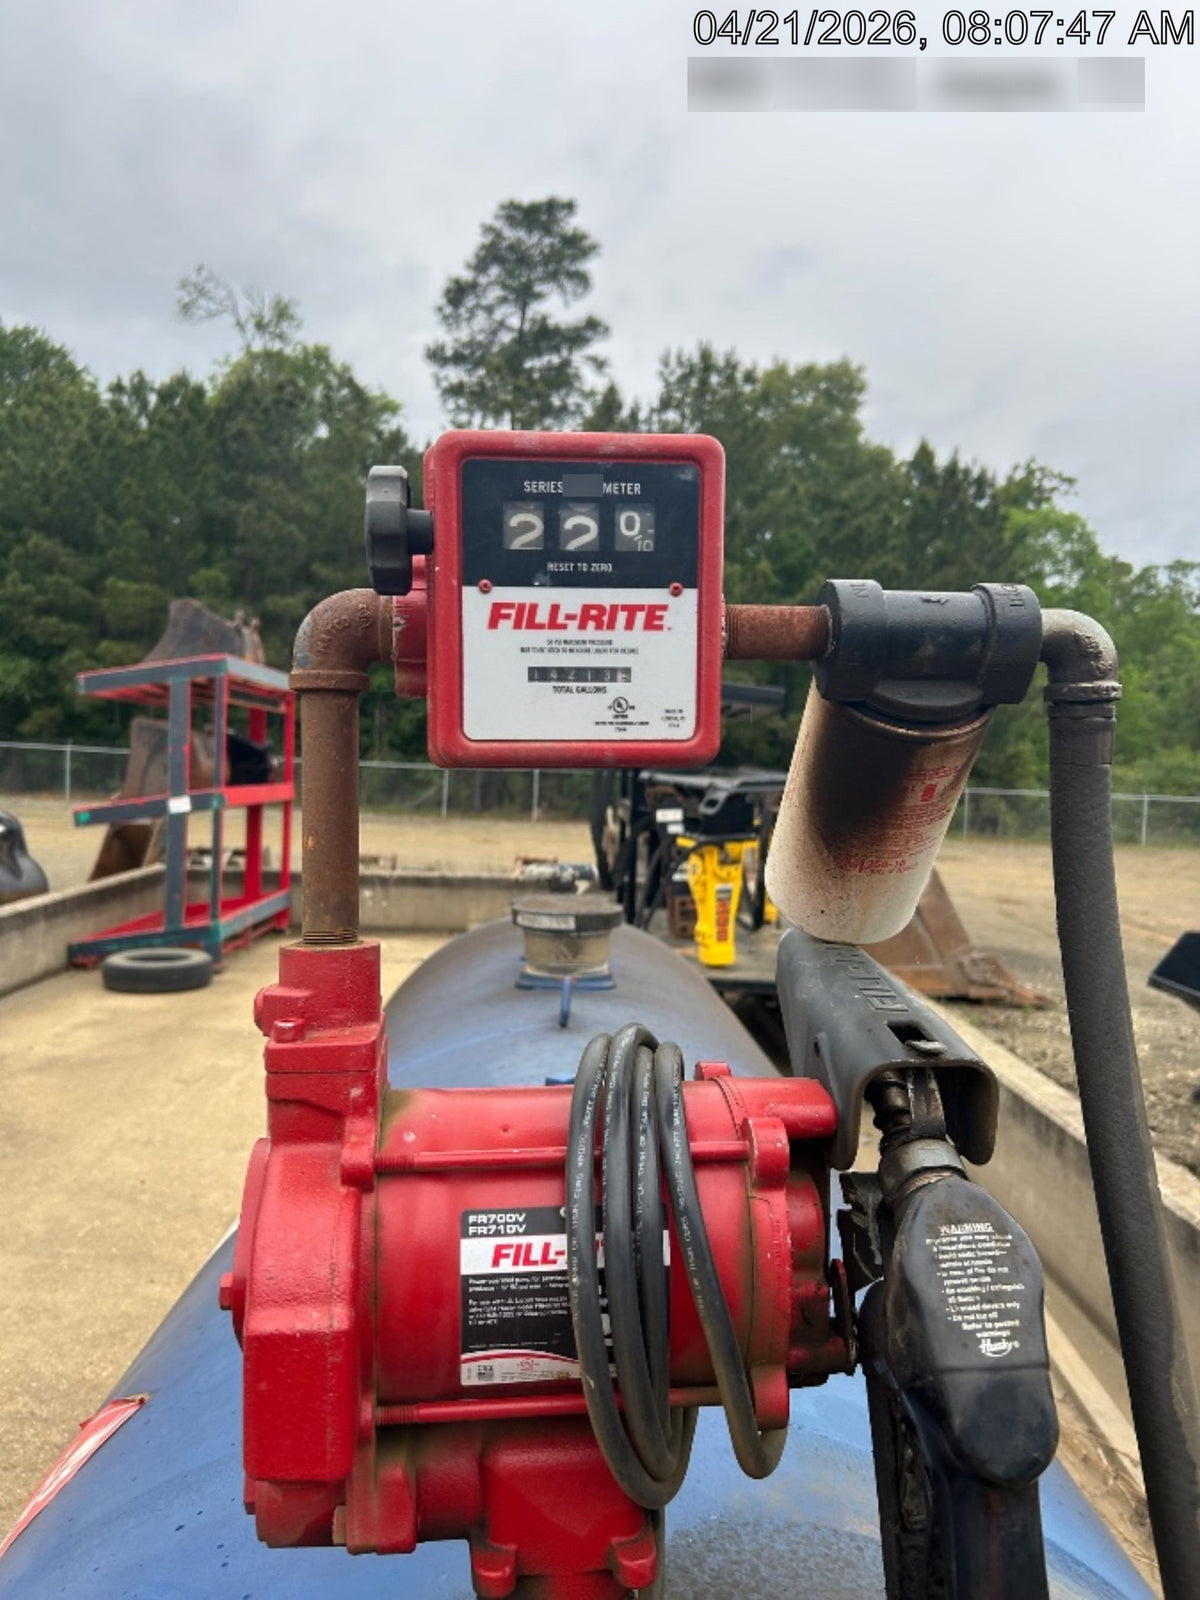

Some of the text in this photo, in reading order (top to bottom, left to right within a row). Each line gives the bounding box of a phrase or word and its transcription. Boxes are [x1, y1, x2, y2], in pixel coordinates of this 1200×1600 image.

[523, 481, 563, 493] SERIES
[603, 482, 641, 495] METER
[547, 562, 573, 572] RESET
[591, 563, 613, 573] ZERO
[487, 602, 669, 631] FILL-RITE
[552, 686, 607, 694] TOTAL GALLONS
[468, 1213, 526, 1224] FR700V
[468, 1224, 527, 1236] FR710V
[491, 1242, 566, 1268] FILL-
[979, 1338, 1013, 1357] Husky
